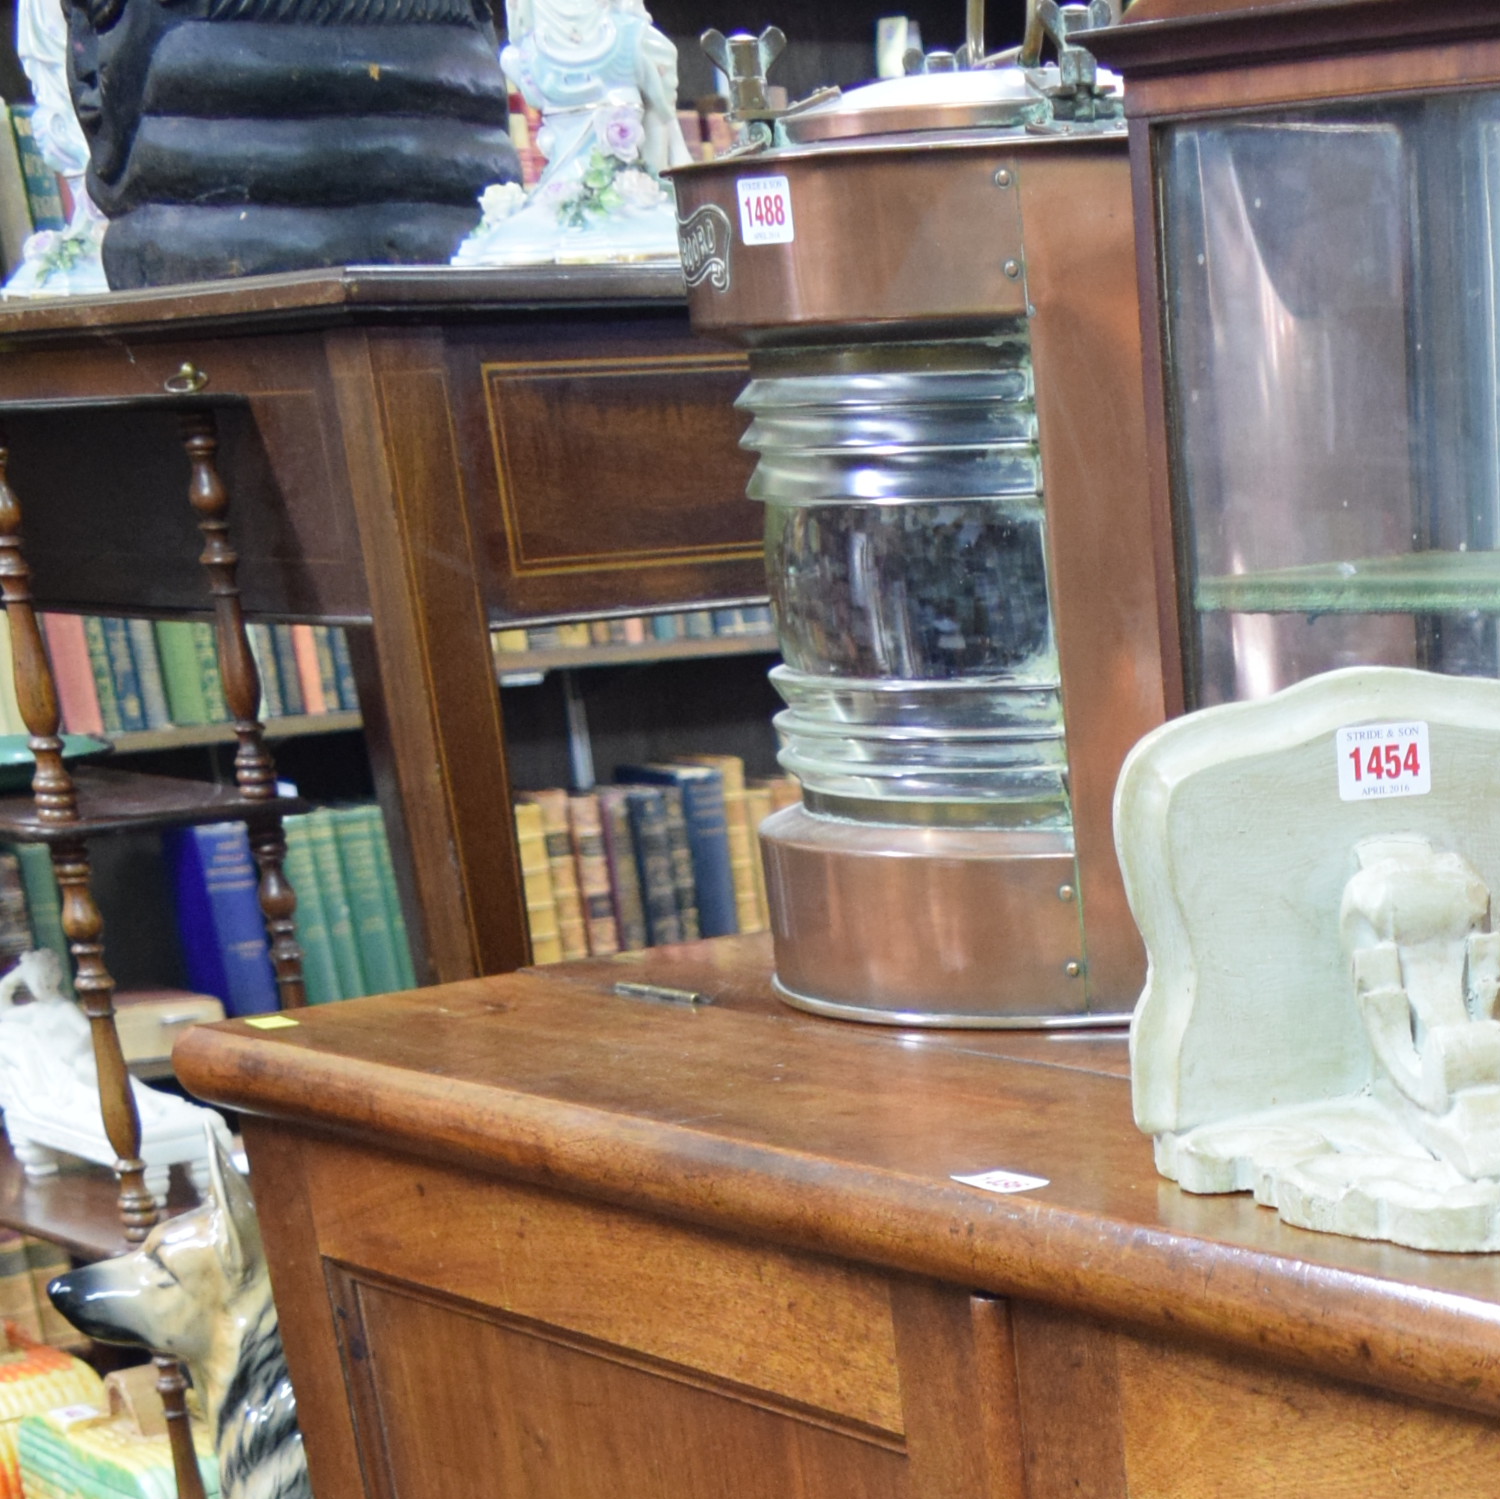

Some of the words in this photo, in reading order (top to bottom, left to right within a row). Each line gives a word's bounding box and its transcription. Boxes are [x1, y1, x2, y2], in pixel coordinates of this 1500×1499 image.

[745, 194, 785, 228] 1488
[1346, 729, 1384, 742] STRIDE
[1386, 728, 1394, 739] &
[1398, 726, 1420, 737] SON
[1348, 742, 1421, 782] 1454
[1362, 785, 1388, 797] APRIL
[1389, 783, 1411, 795] 2016
